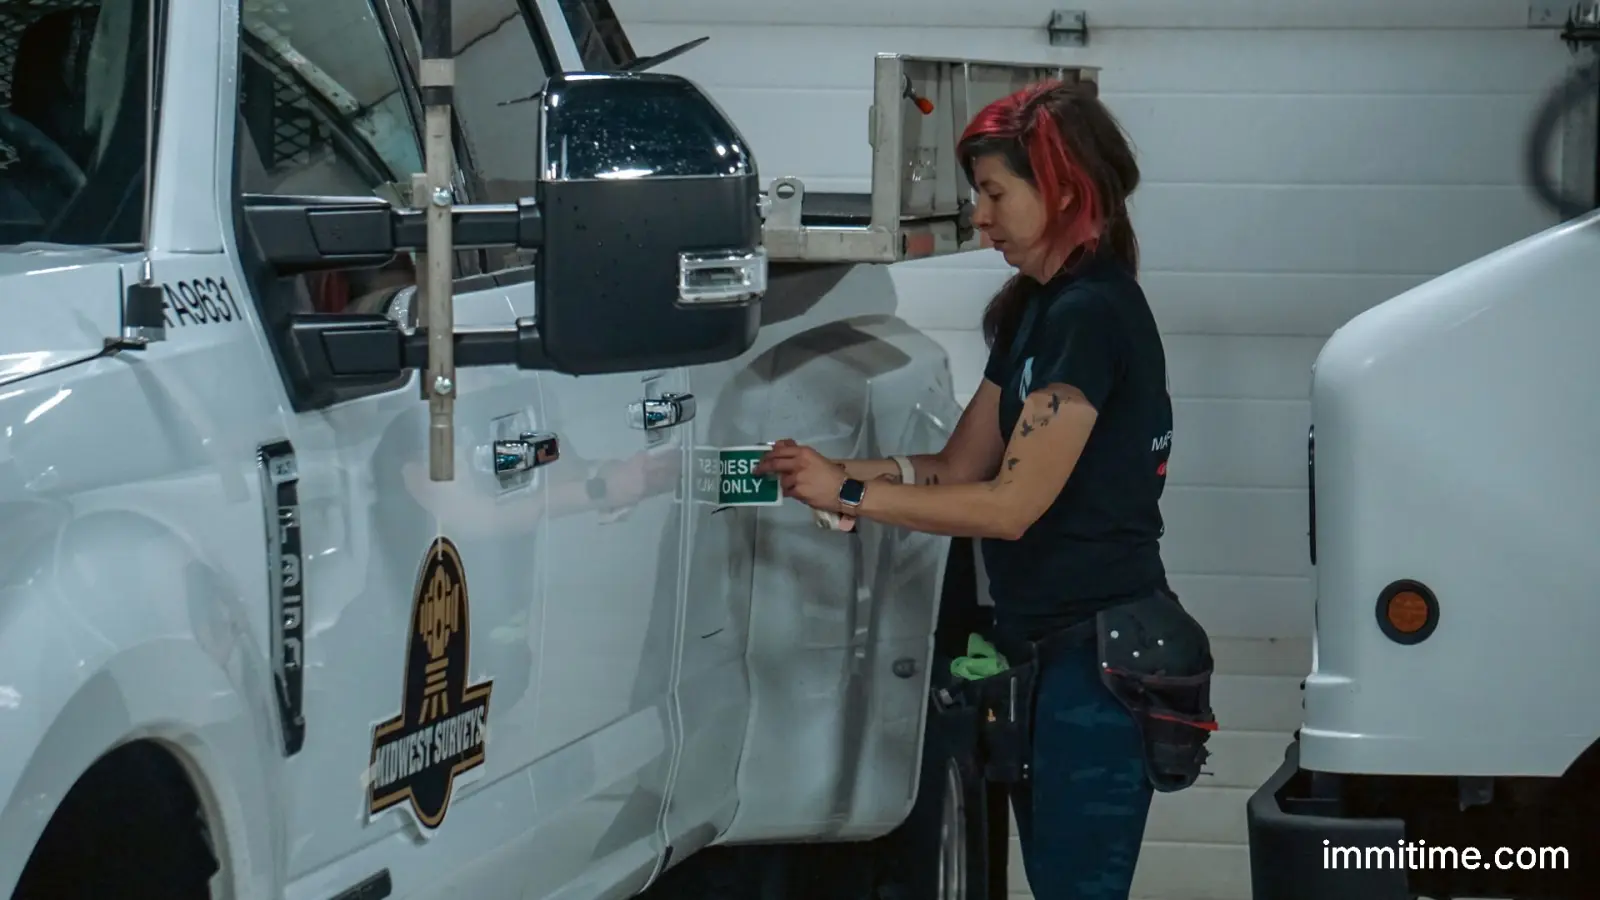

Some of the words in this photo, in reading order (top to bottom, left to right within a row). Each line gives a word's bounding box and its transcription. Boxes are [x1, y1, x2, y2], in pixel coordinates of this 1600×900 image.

[722, 478, 763, 495] ONLY
[373, 725, 435, 790] MIDWEST
[433, 704, 486, 765] SURVEYS
